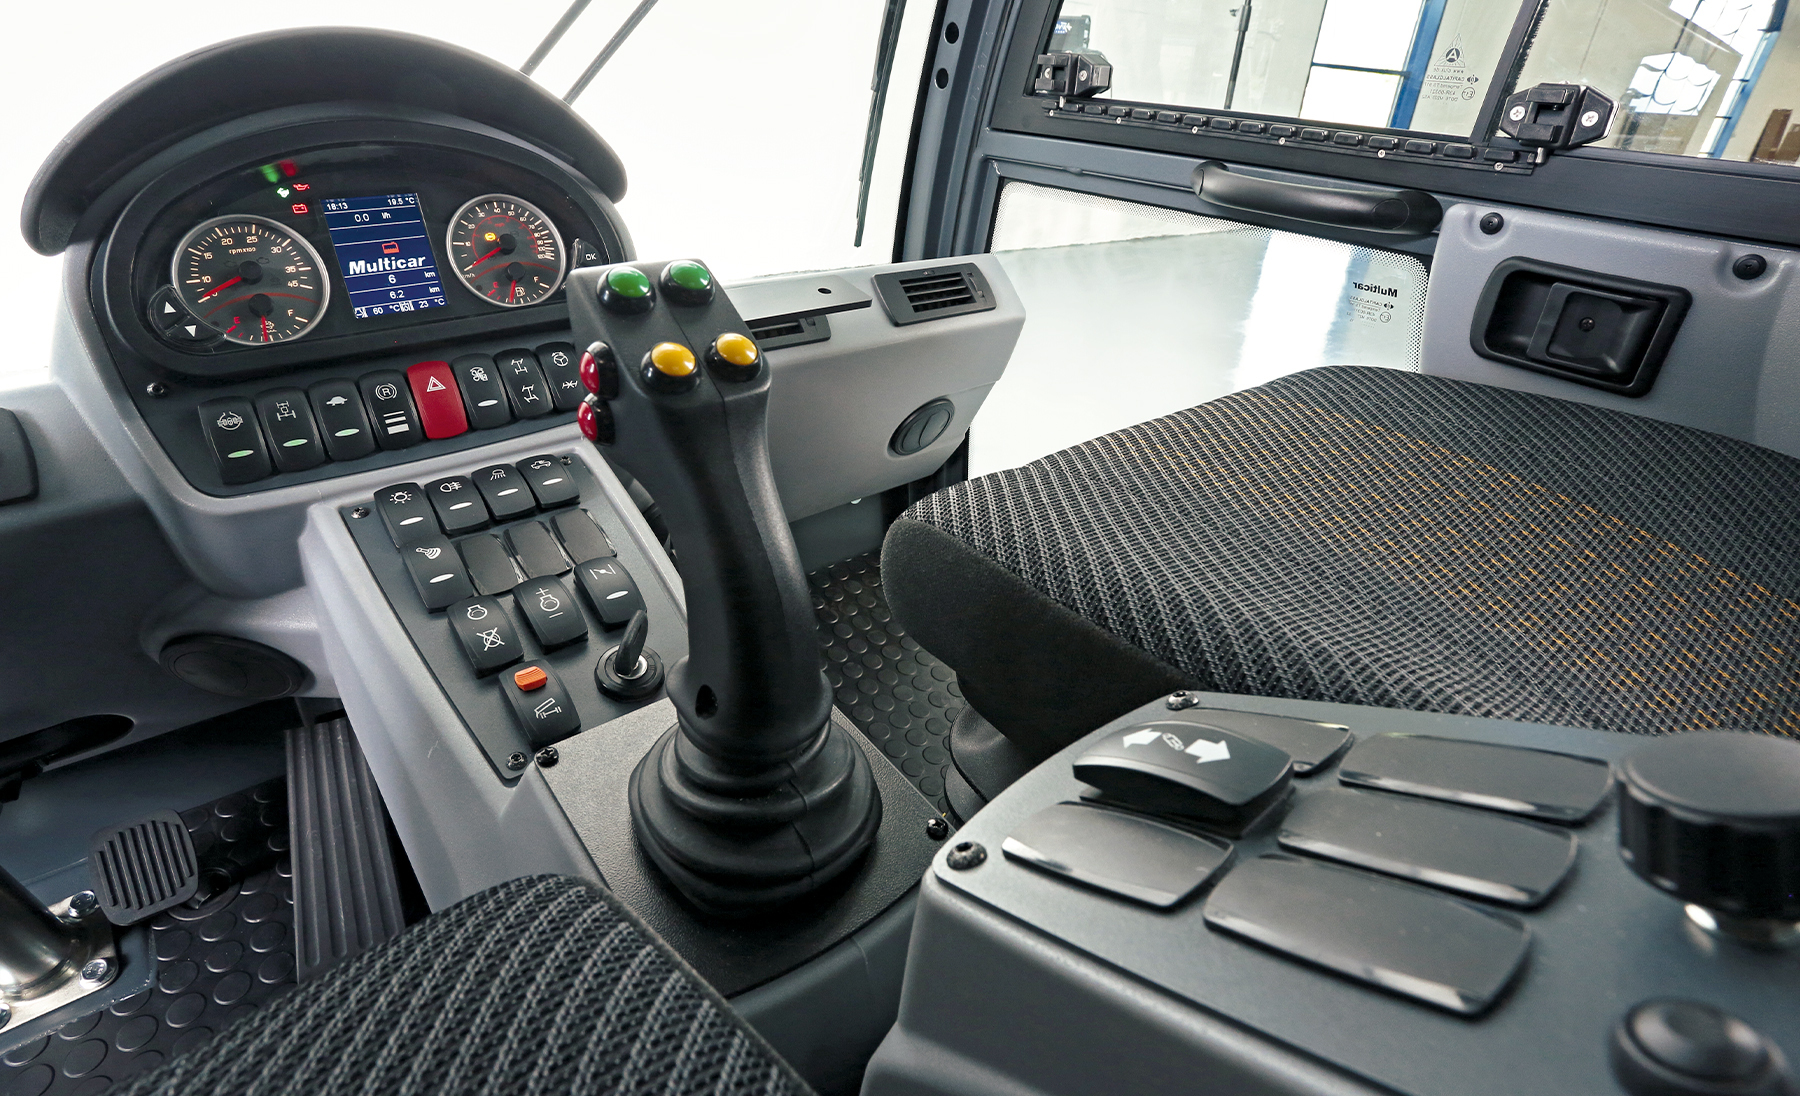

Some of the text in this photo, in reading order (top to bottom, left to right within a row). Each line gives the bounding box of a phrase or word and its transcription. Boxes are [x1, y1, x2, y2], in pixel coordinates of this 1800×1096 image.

[327, 202, 348, 210] 18:13
[355, 214, 369, 222] 0.0
[349, 256, 426, 275] Multicar
[388, 274, 397, 284] 6
[390, 290, 405, 299] 6.2
